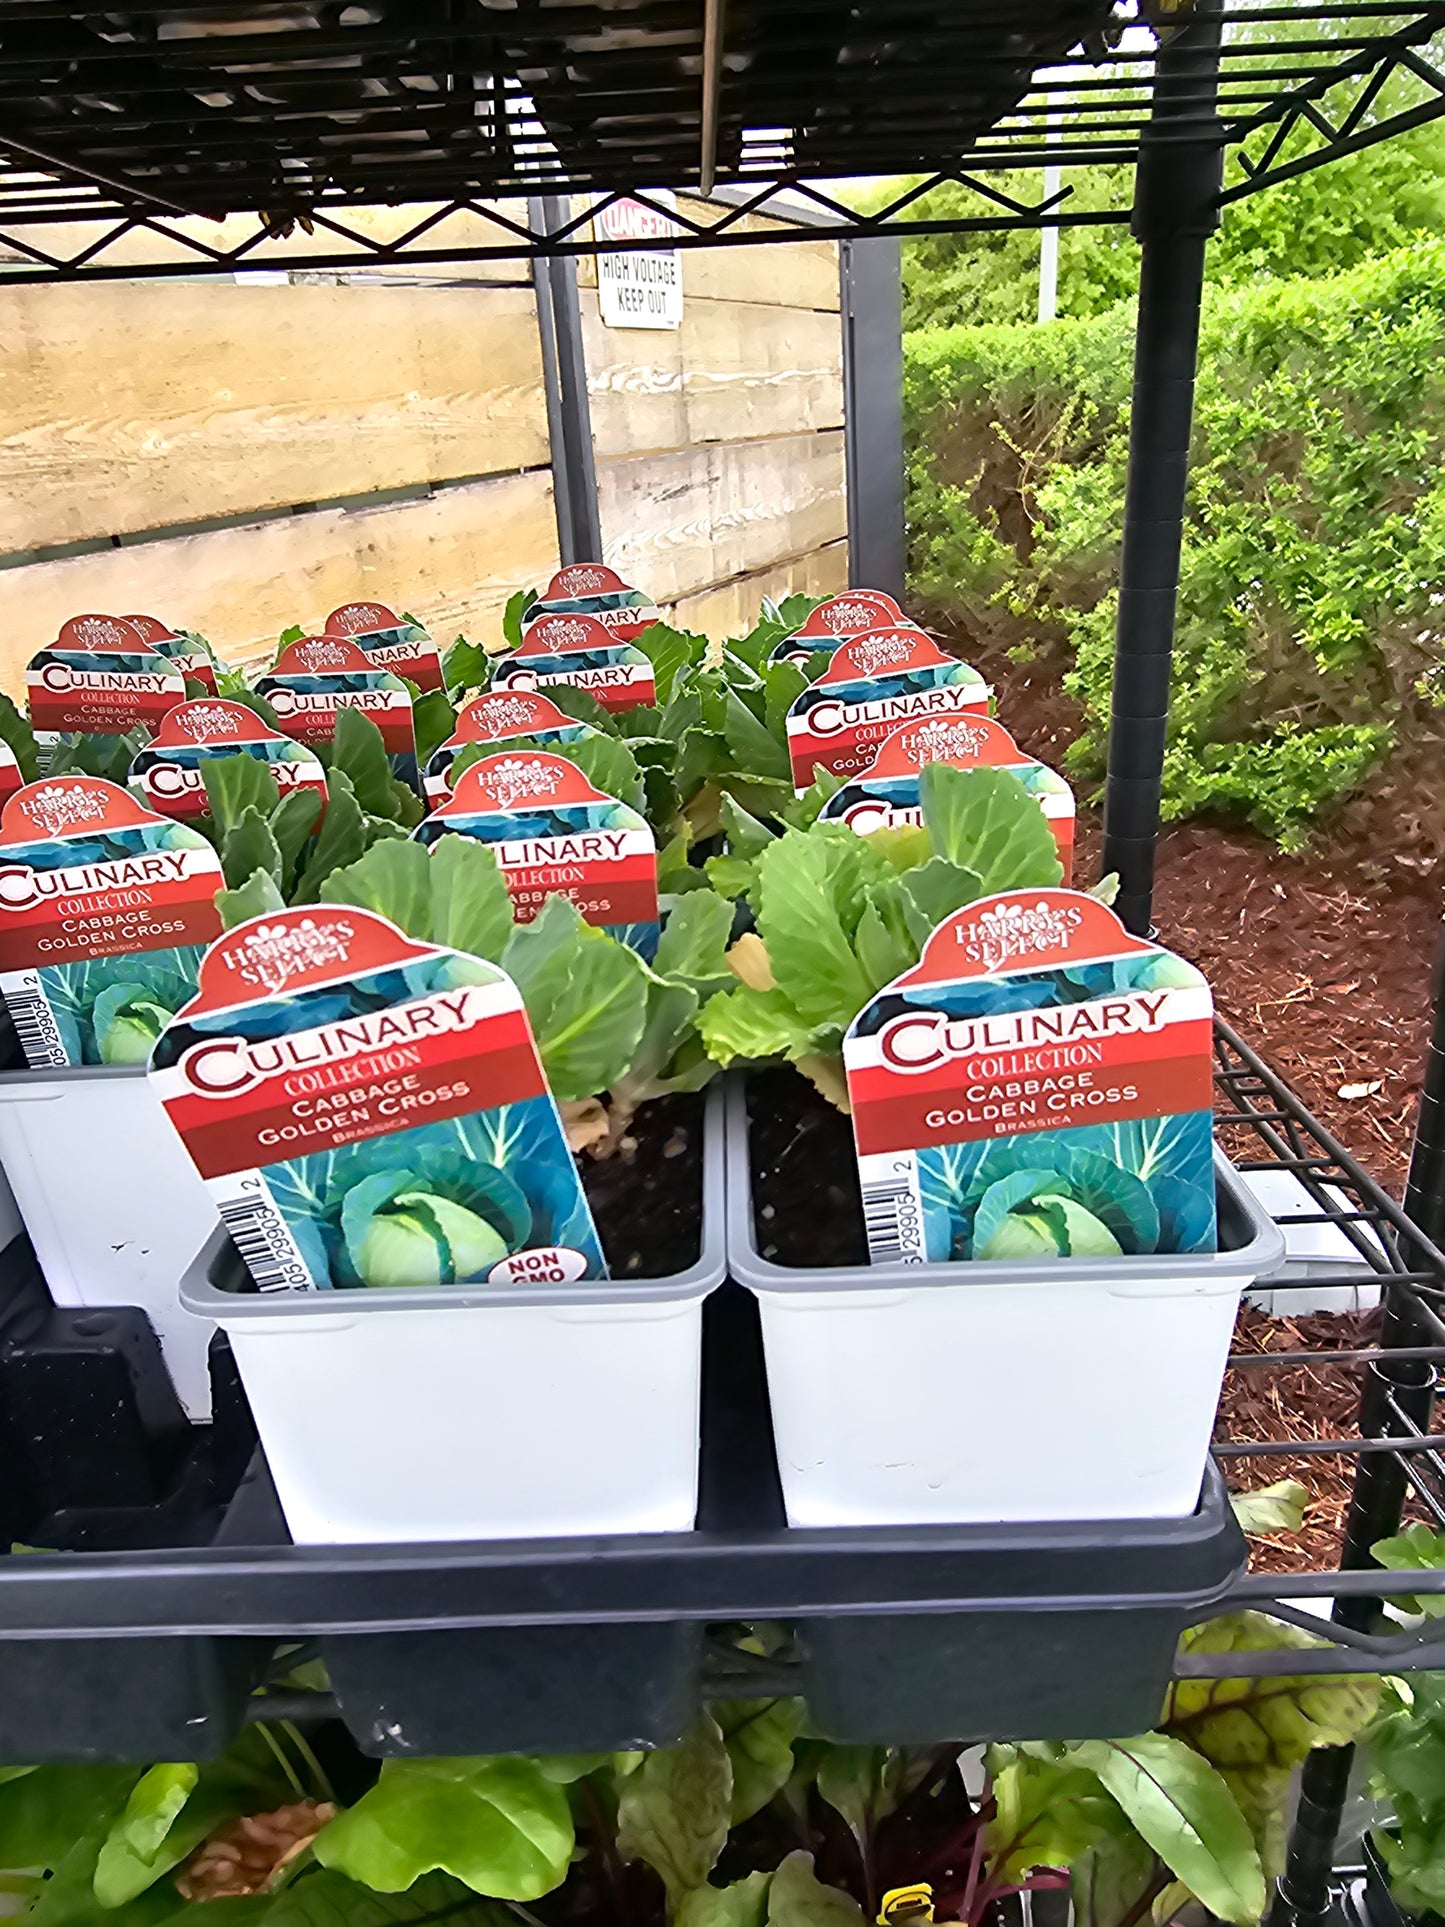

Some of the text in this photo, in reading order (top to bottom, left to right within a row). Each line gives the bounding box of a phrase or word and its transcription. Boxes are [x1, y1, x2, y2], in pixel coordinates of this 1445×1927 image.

[603, 255, 676, 285] HIGH VOLTAGE
[617, 287, 666, 314] KEEP OUT
[366, 643, 421, 663] NARY
[43, 665, 167, 691] CULINARY
[81, 693, 140, 704] COLLECTION
[81, 704, 136, 715] CABBAGE
[267, 692, 392, 716] CULINARY
[808, 688, 965, 733] CULINARY
[63, 713, 157, 726] GOLDEN CROSS
[833, 756, 875, 770] GOLD
[492, 834, 627, 864] LINARY
[0, 854, 187, 907] CULINARY
[505, 867, 584, 887] OLLECTION
[58, 888, 153, 916] COLLECTION
[509, 888, 580, 903] ABBGE
[575, 900, 611, 913] OSS
[62, 910, 151, 932] CABBAGE
[37, 920, 185, 951] GOLDEN CROSS
[89, 942, 143, 956] BRASSICA
[185, 993, 468, 1092] CULINARY
[882, 994, 1168, 1068] CULINARY
[284, 1046, 421, 1097] COLLECTION
[967, 1043, 1103, 1081] COLLECTION
[292, 1074, 421, 1117] CABBAGE
[966, 1072, 1093, 1102] CABBAGE
[258, 1081, 470, 1145] GOLDEN CROSS
[925, 1086, 1138, 1128] GOLDEN CROSS
[332, 1118, 409, 1144] BRASSICA
[995, 1115, 1072, 1134] BRASSICA
[508, 1252, 559, 1274] NON
